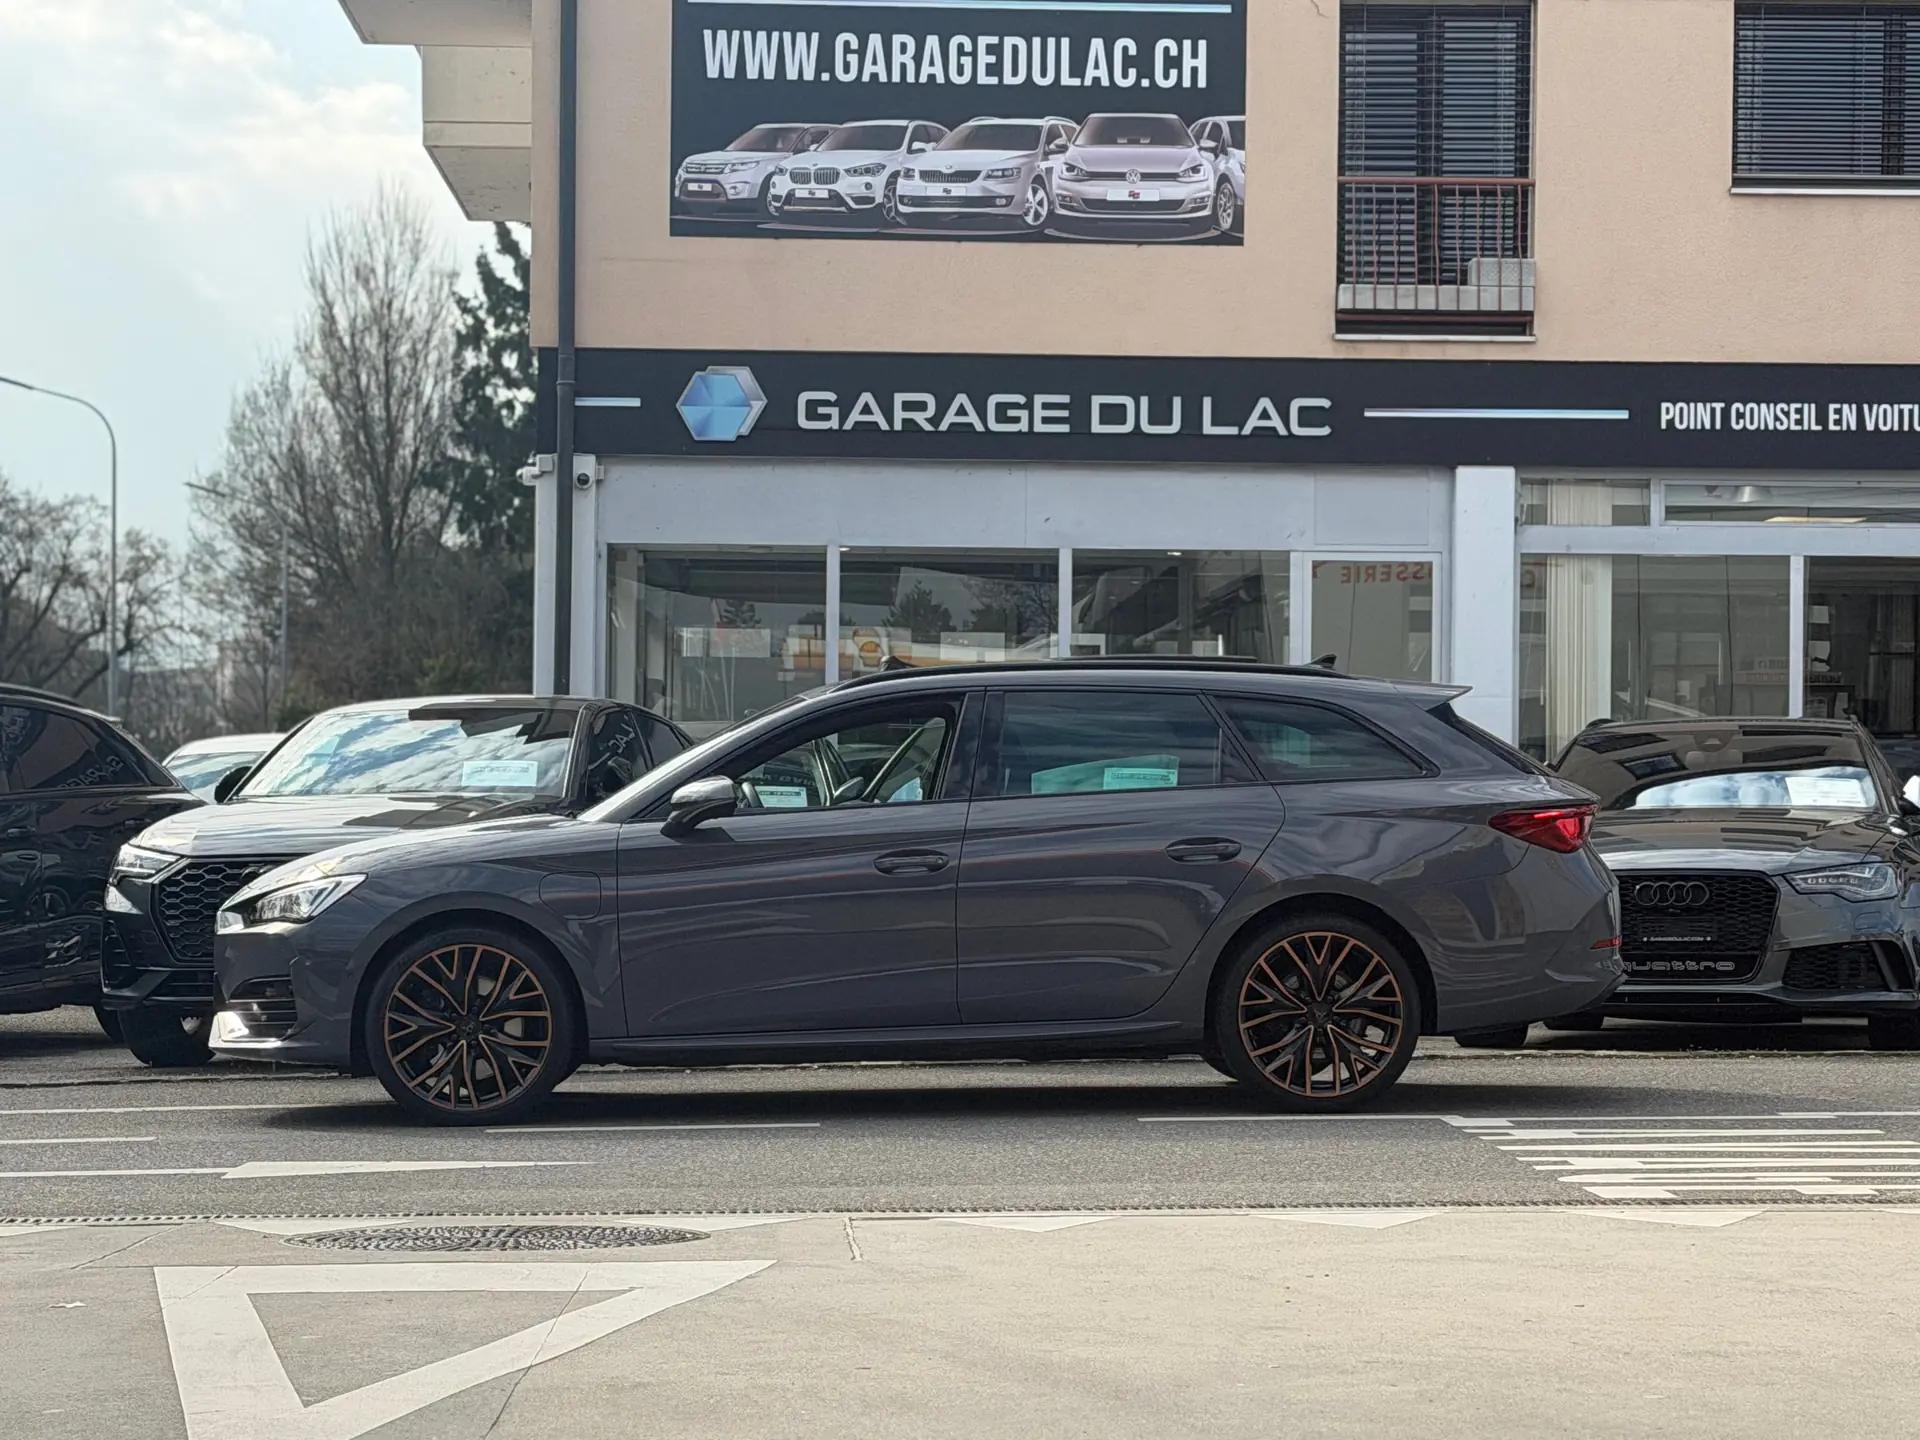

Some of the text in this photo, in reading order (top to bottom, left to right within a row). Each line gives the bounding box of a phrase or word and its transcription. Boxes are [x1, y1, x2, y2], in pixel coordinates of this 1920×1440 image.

[702, 29, 1208, 89] WWW.GARAGEDULAC.CH
[797, 391, 1332, 436] GARAGE DU LAC
[1660, 401, 1726, 430] POINT
[1730, 402, 1823, 431] CONSEIL
[1828, 403, 1857, 431] EN
